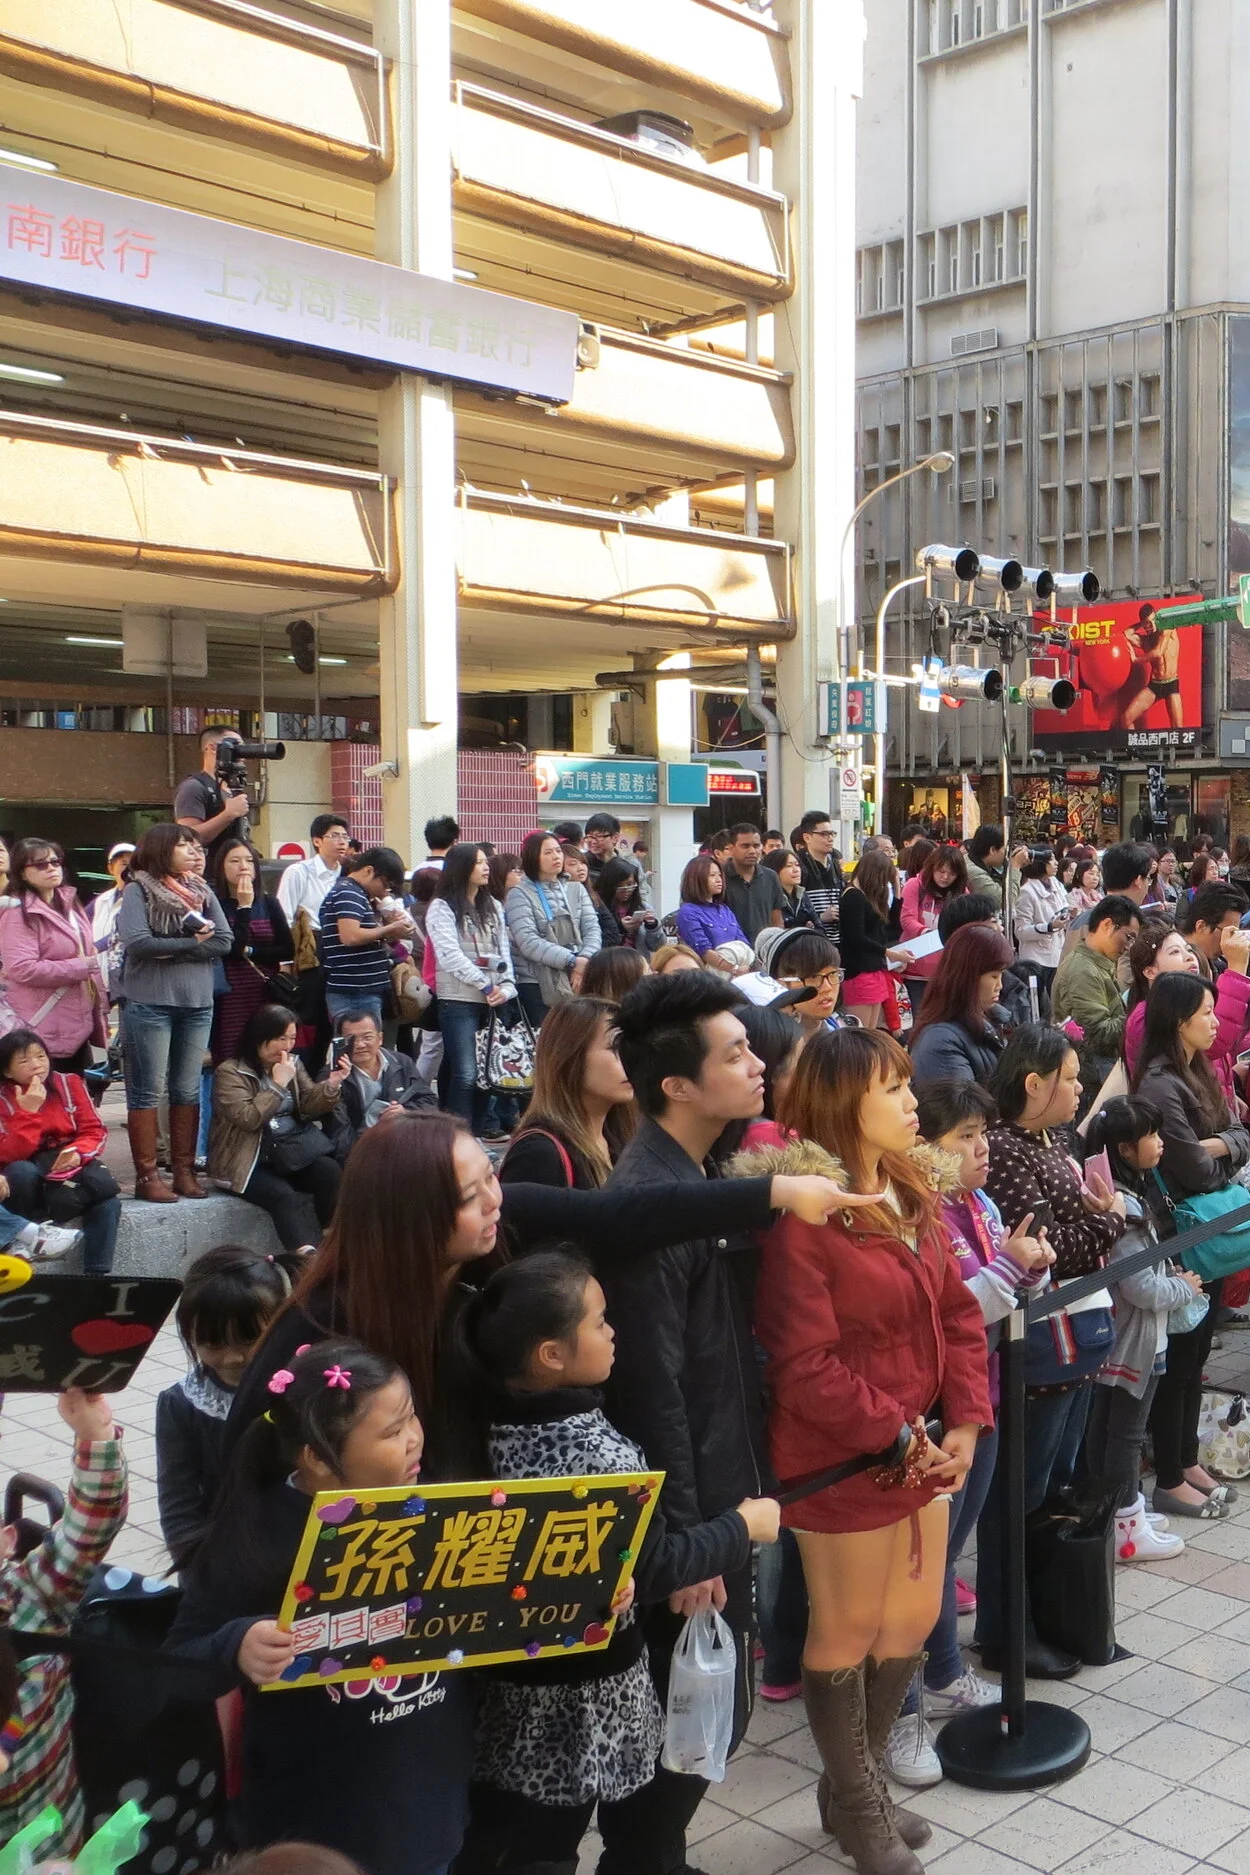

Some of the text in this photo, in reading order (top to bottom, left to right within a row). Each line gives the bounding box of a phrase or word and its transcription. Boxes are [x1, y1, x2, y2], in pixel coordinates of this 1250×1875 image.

[0, 203, 157, 280] 南銀行
[204, 252, 536, 369] 上海商業儲蓄銀行
[1128, 732, 1195, 746] 誠品西門店 2F
[561, 771, 658, 793] 西門就業服務站
[319, 1500, 618, 1601] 孫耀威
[404, 1603, 582, 1640] LOVE YOU
[370, 1687, 446, 1726] Hello Kitty
